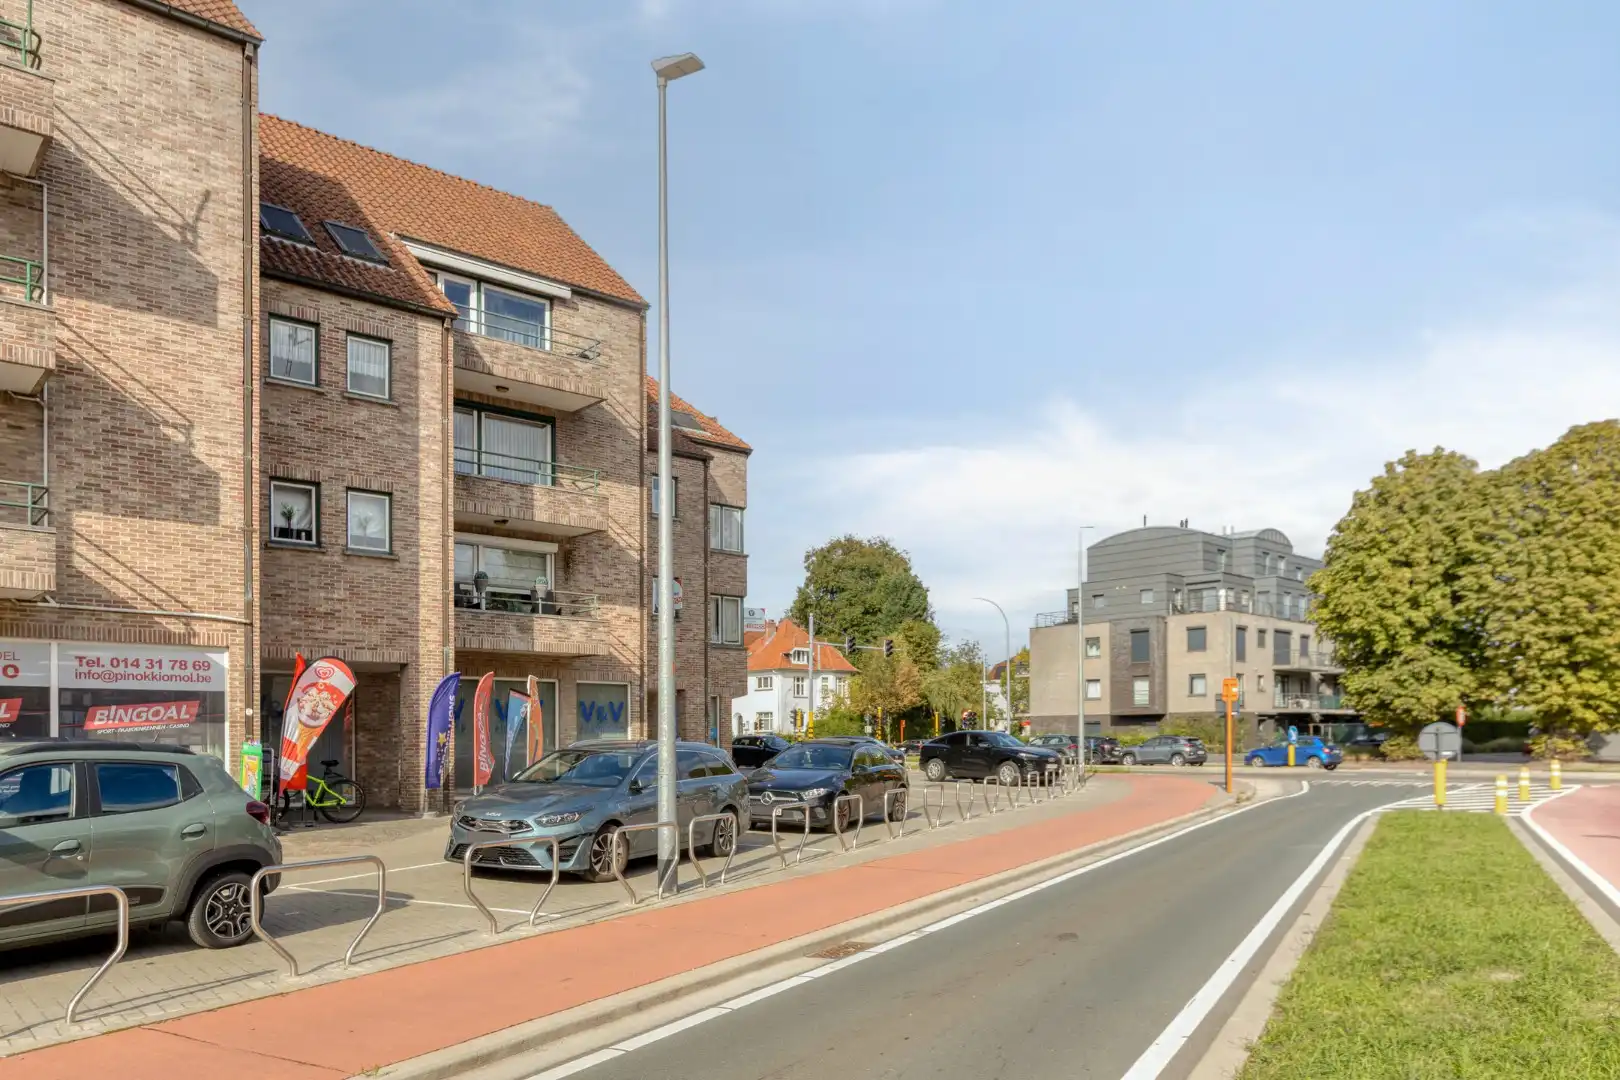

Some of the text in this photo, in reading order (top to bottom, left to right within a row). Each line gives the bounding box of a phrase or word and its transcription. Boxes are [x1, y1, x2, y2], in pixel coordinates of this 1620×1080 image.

[75, 656, 211, 671] Tel. 014 31 78 69
[75, 669, 212, 683] info@pinokkiomol.be
